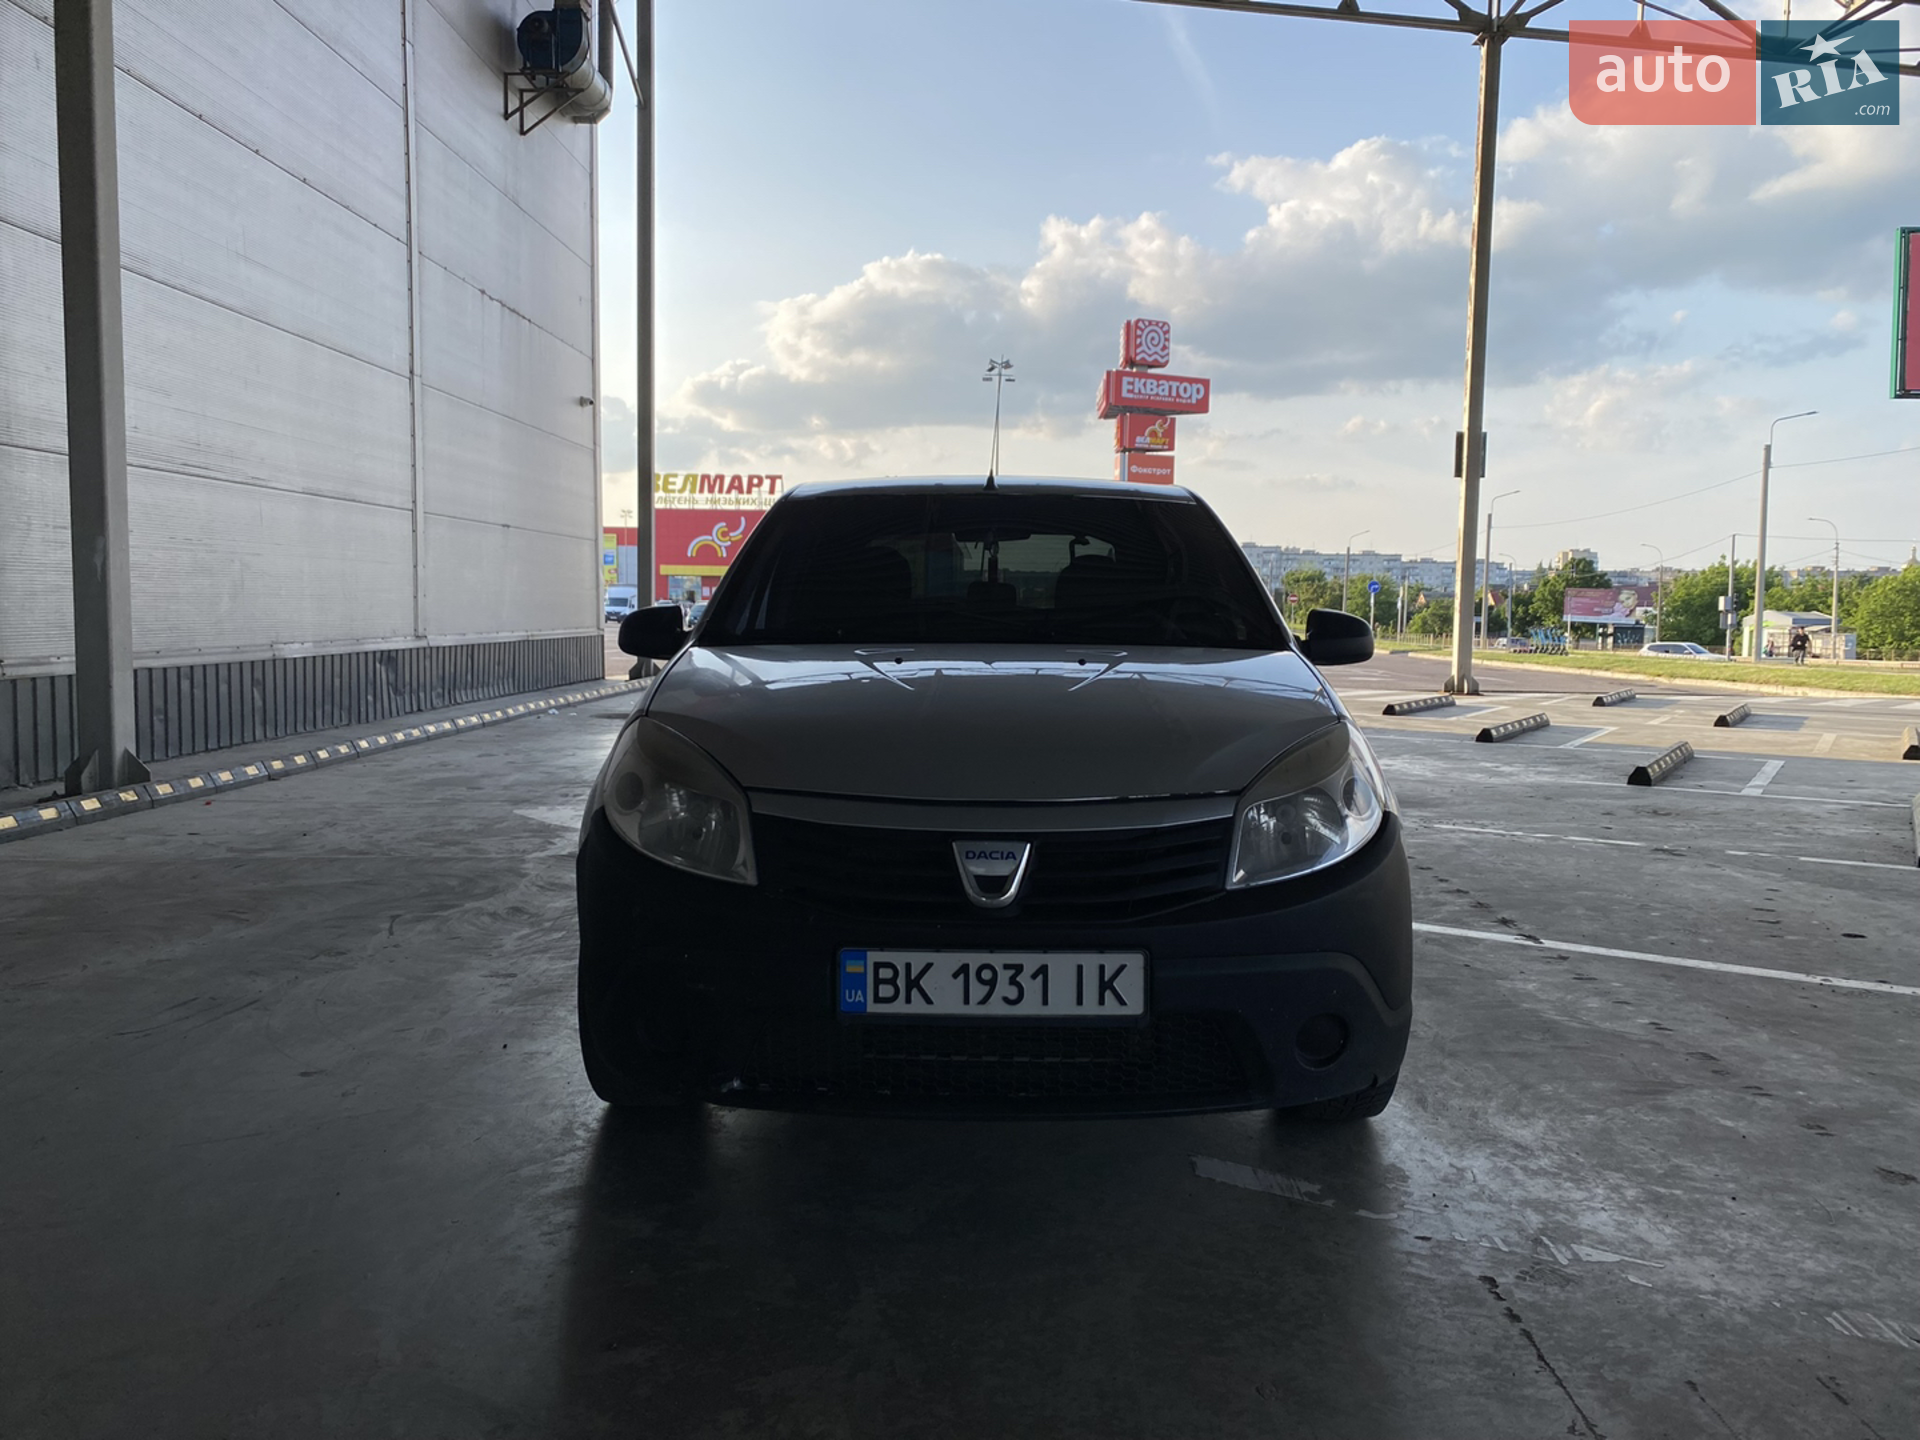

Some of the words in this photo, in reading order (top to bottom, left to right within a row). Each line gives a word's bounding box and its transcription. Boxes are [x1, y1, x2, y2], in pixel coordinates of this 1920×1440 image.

[964, 850, 1017, 861] DACIA
[872, 961, 935, 1005] BK
[951, 962, 1050, 1006] 1931
[1075, 963, 1128, 1007] IK
[845, 989, 865, 1002] UA
